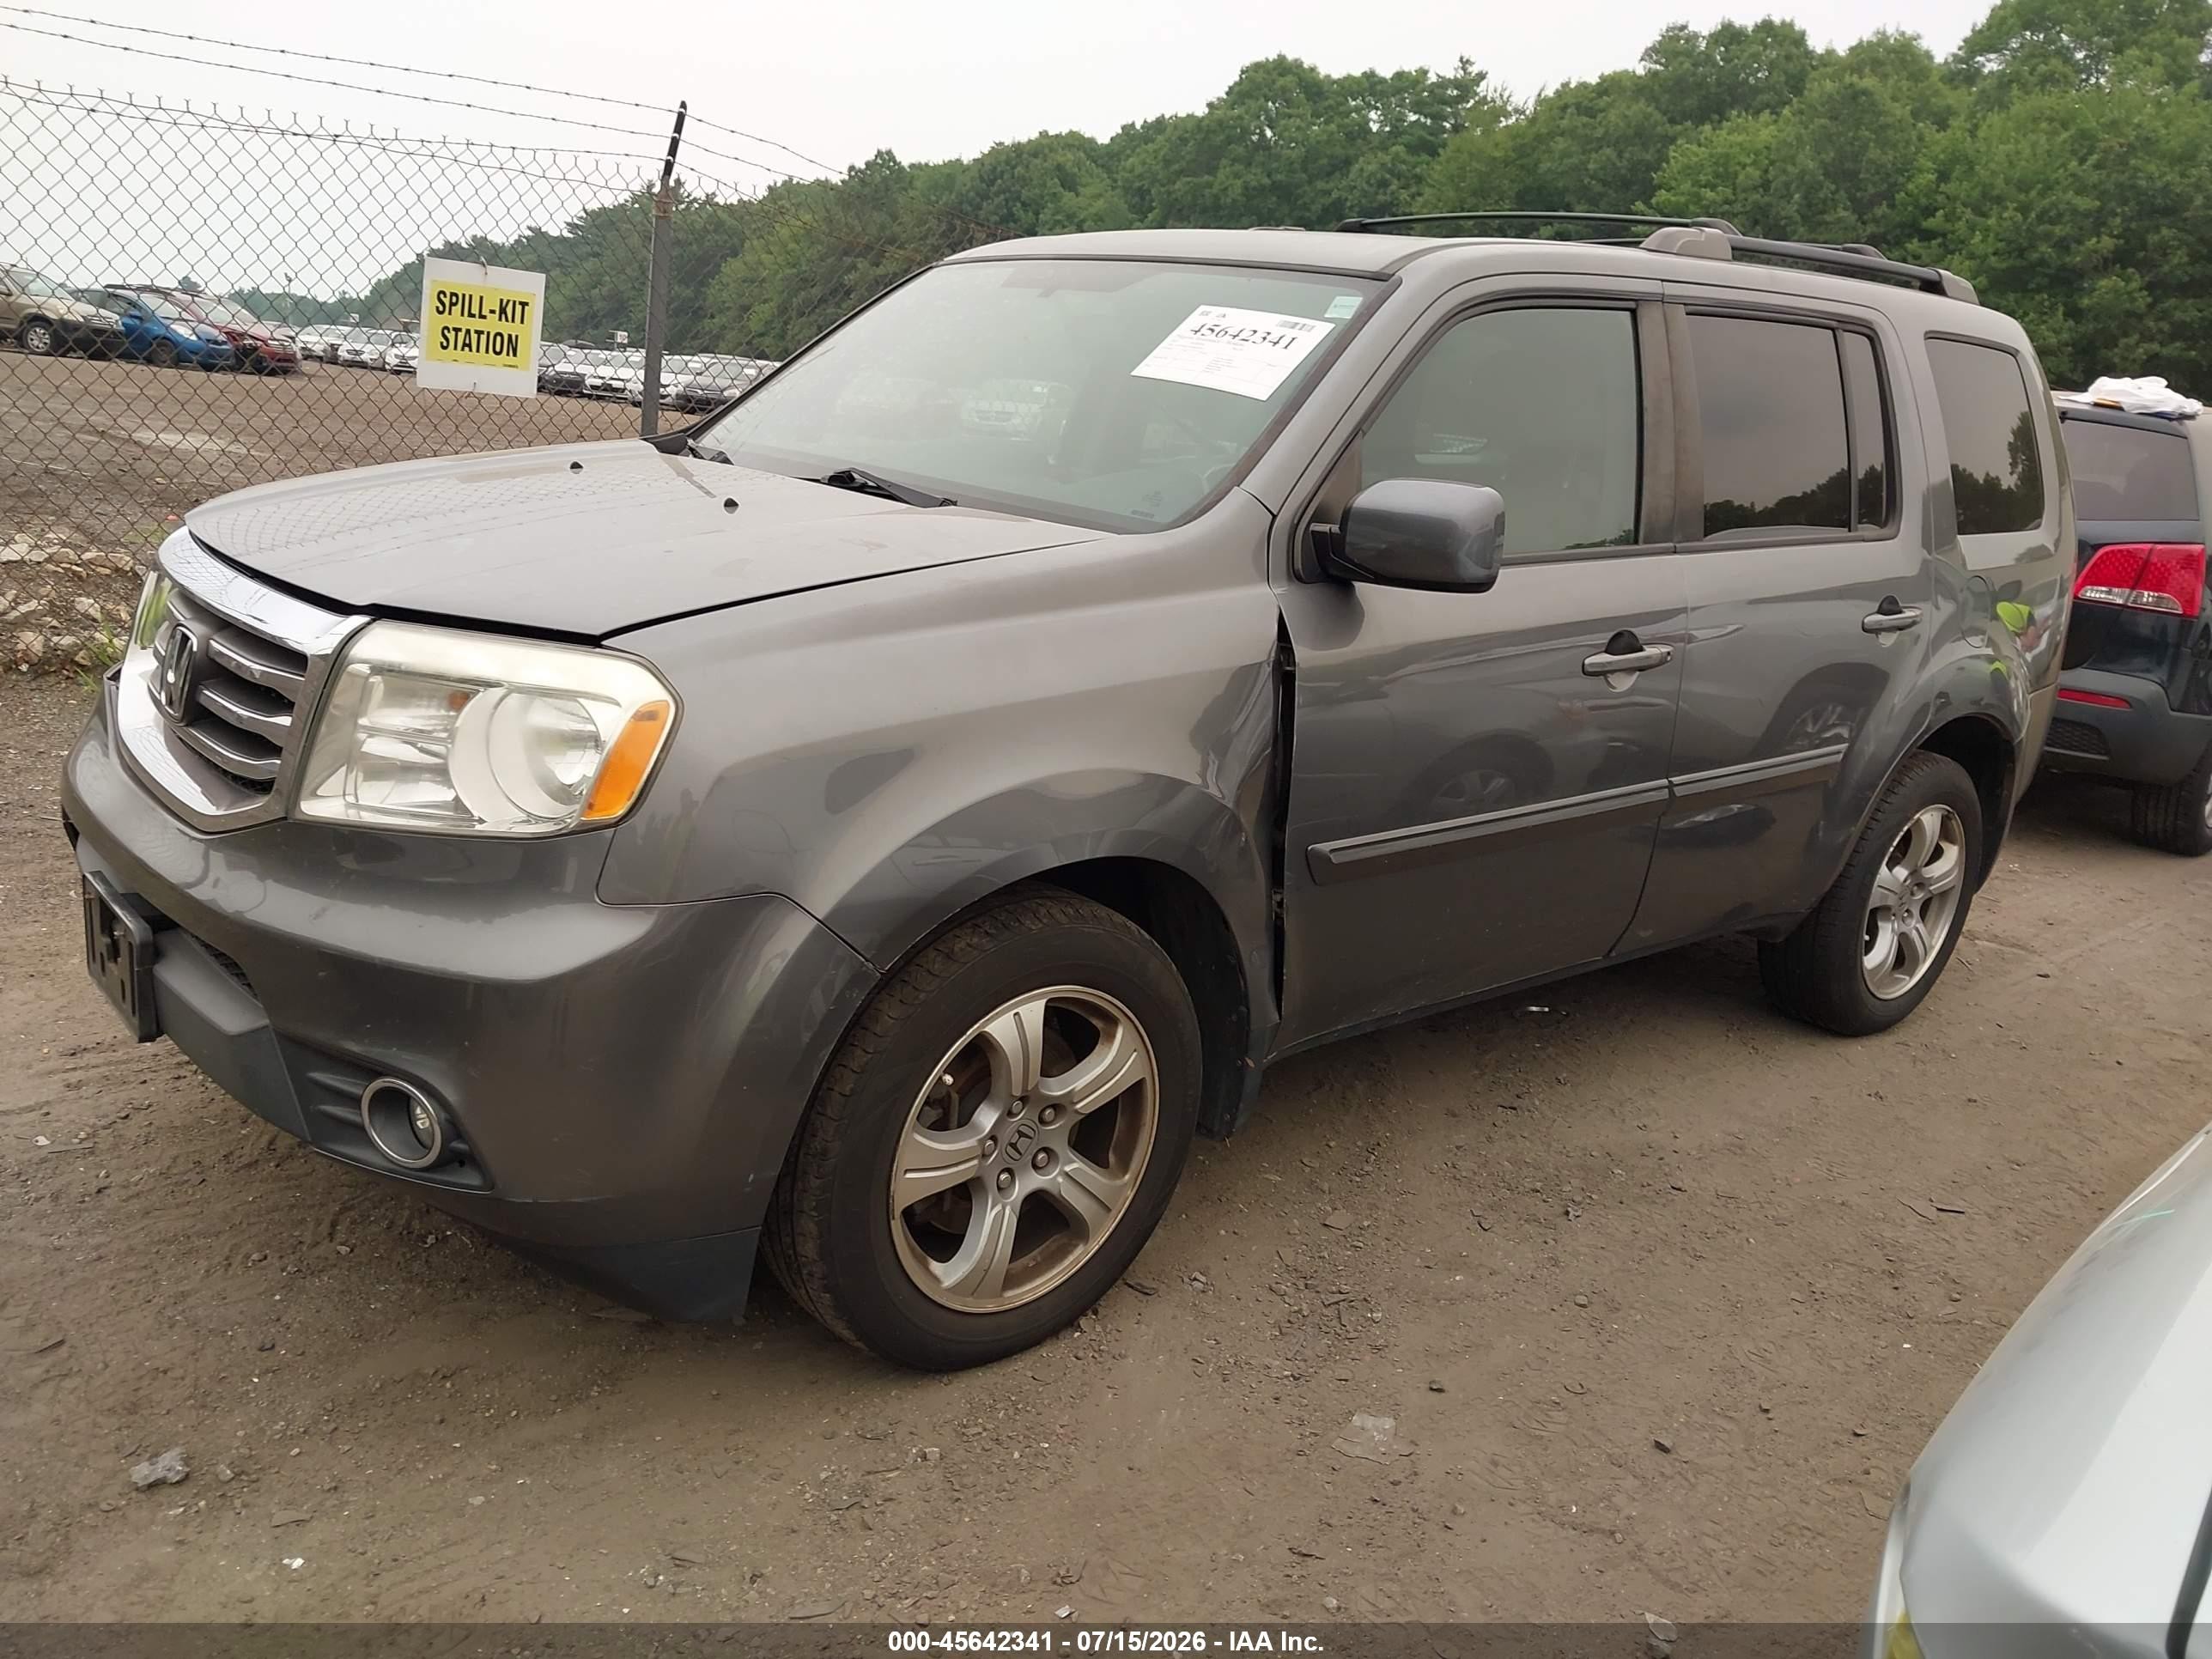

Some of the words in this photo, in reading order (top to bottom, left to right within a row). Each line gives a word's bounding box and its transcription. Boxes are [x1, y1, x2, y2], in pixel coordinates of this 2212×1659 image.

[435, 289, 529, 324] SPILL-KIT
[440, 325, 519, 358] STATION
[1190, 323, 1297, 349] 45642341
